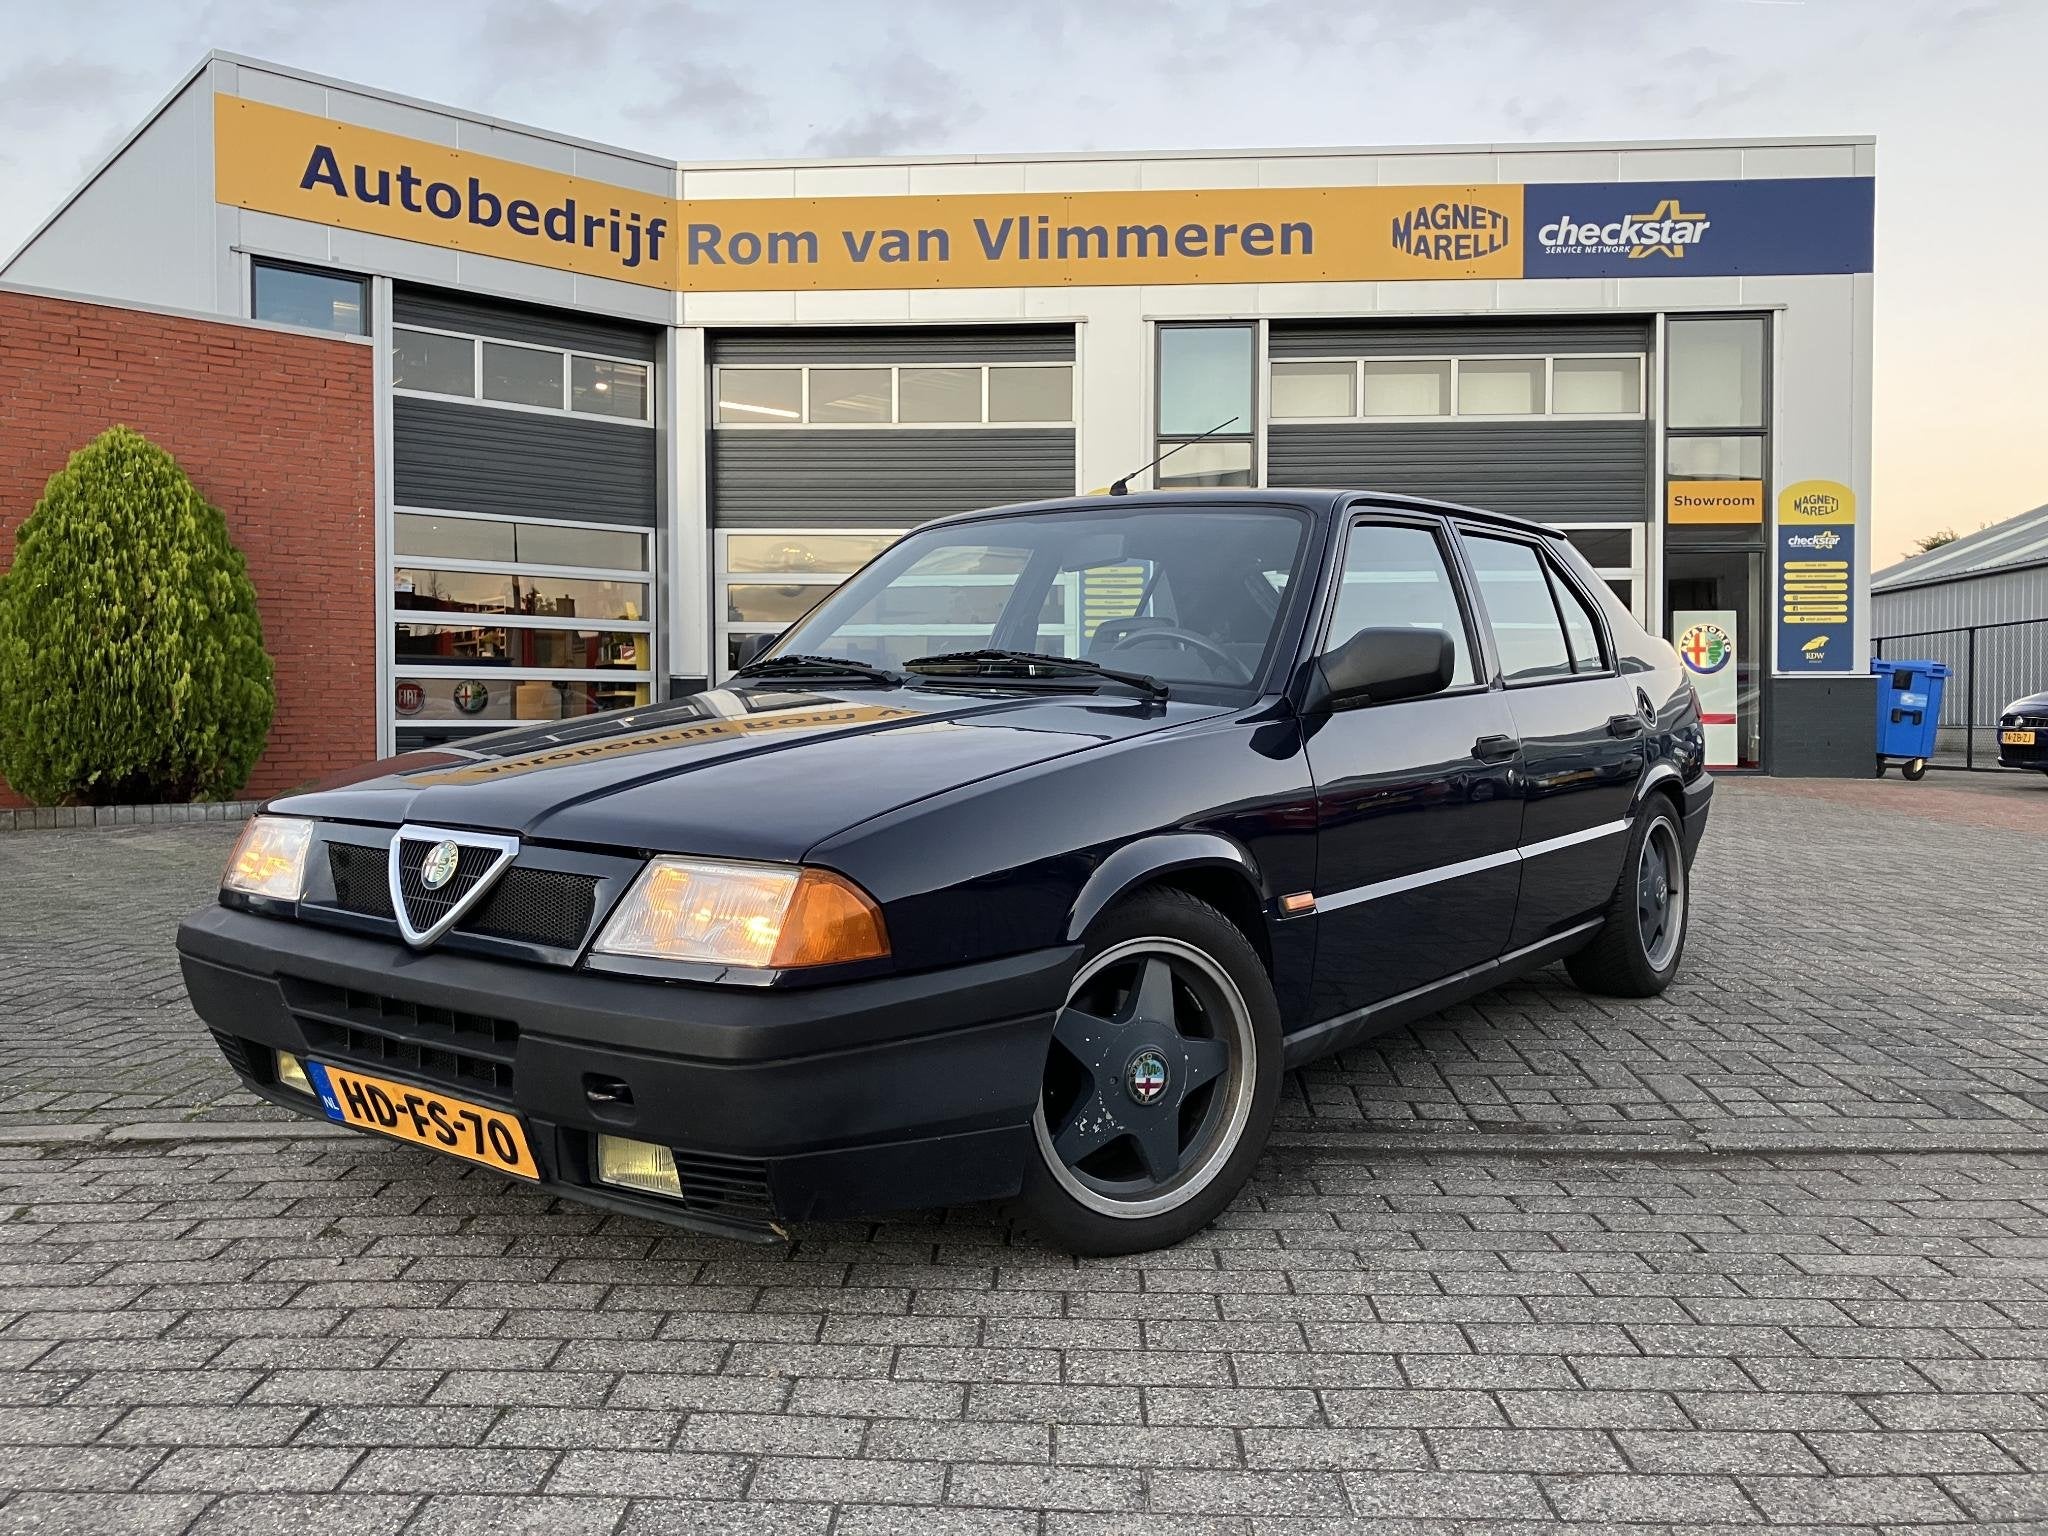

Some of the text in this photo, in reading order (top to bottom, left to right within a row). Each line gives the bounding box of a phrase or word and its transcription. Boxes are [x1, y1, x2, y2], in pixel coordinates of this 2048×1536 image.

[300, 144, 667, 267] Autobedrijf
[1392, 203, 1508, 236] MAGNETI
[1538, 214, 1711, 246] checkstar
[687, 215, 1314, 265] Rom van Vlimmeren
[1392, 228, 1508, 262] MARELLI
[1545, 245, 1631, 254] SERVICE NETWORK
[1674, 495, 1755, 506] Showroom
[1794, 494, 1838, 507] MAGNETI
[1788, 535, 1840, 545] checkstar
[1701, 626, 1731, 652] ROMEO
[398, 689, 418, 705] FIAT
[323, 1095, 340, 1111] NL
[339, 1077, 519, 1165] HD-FS-70
